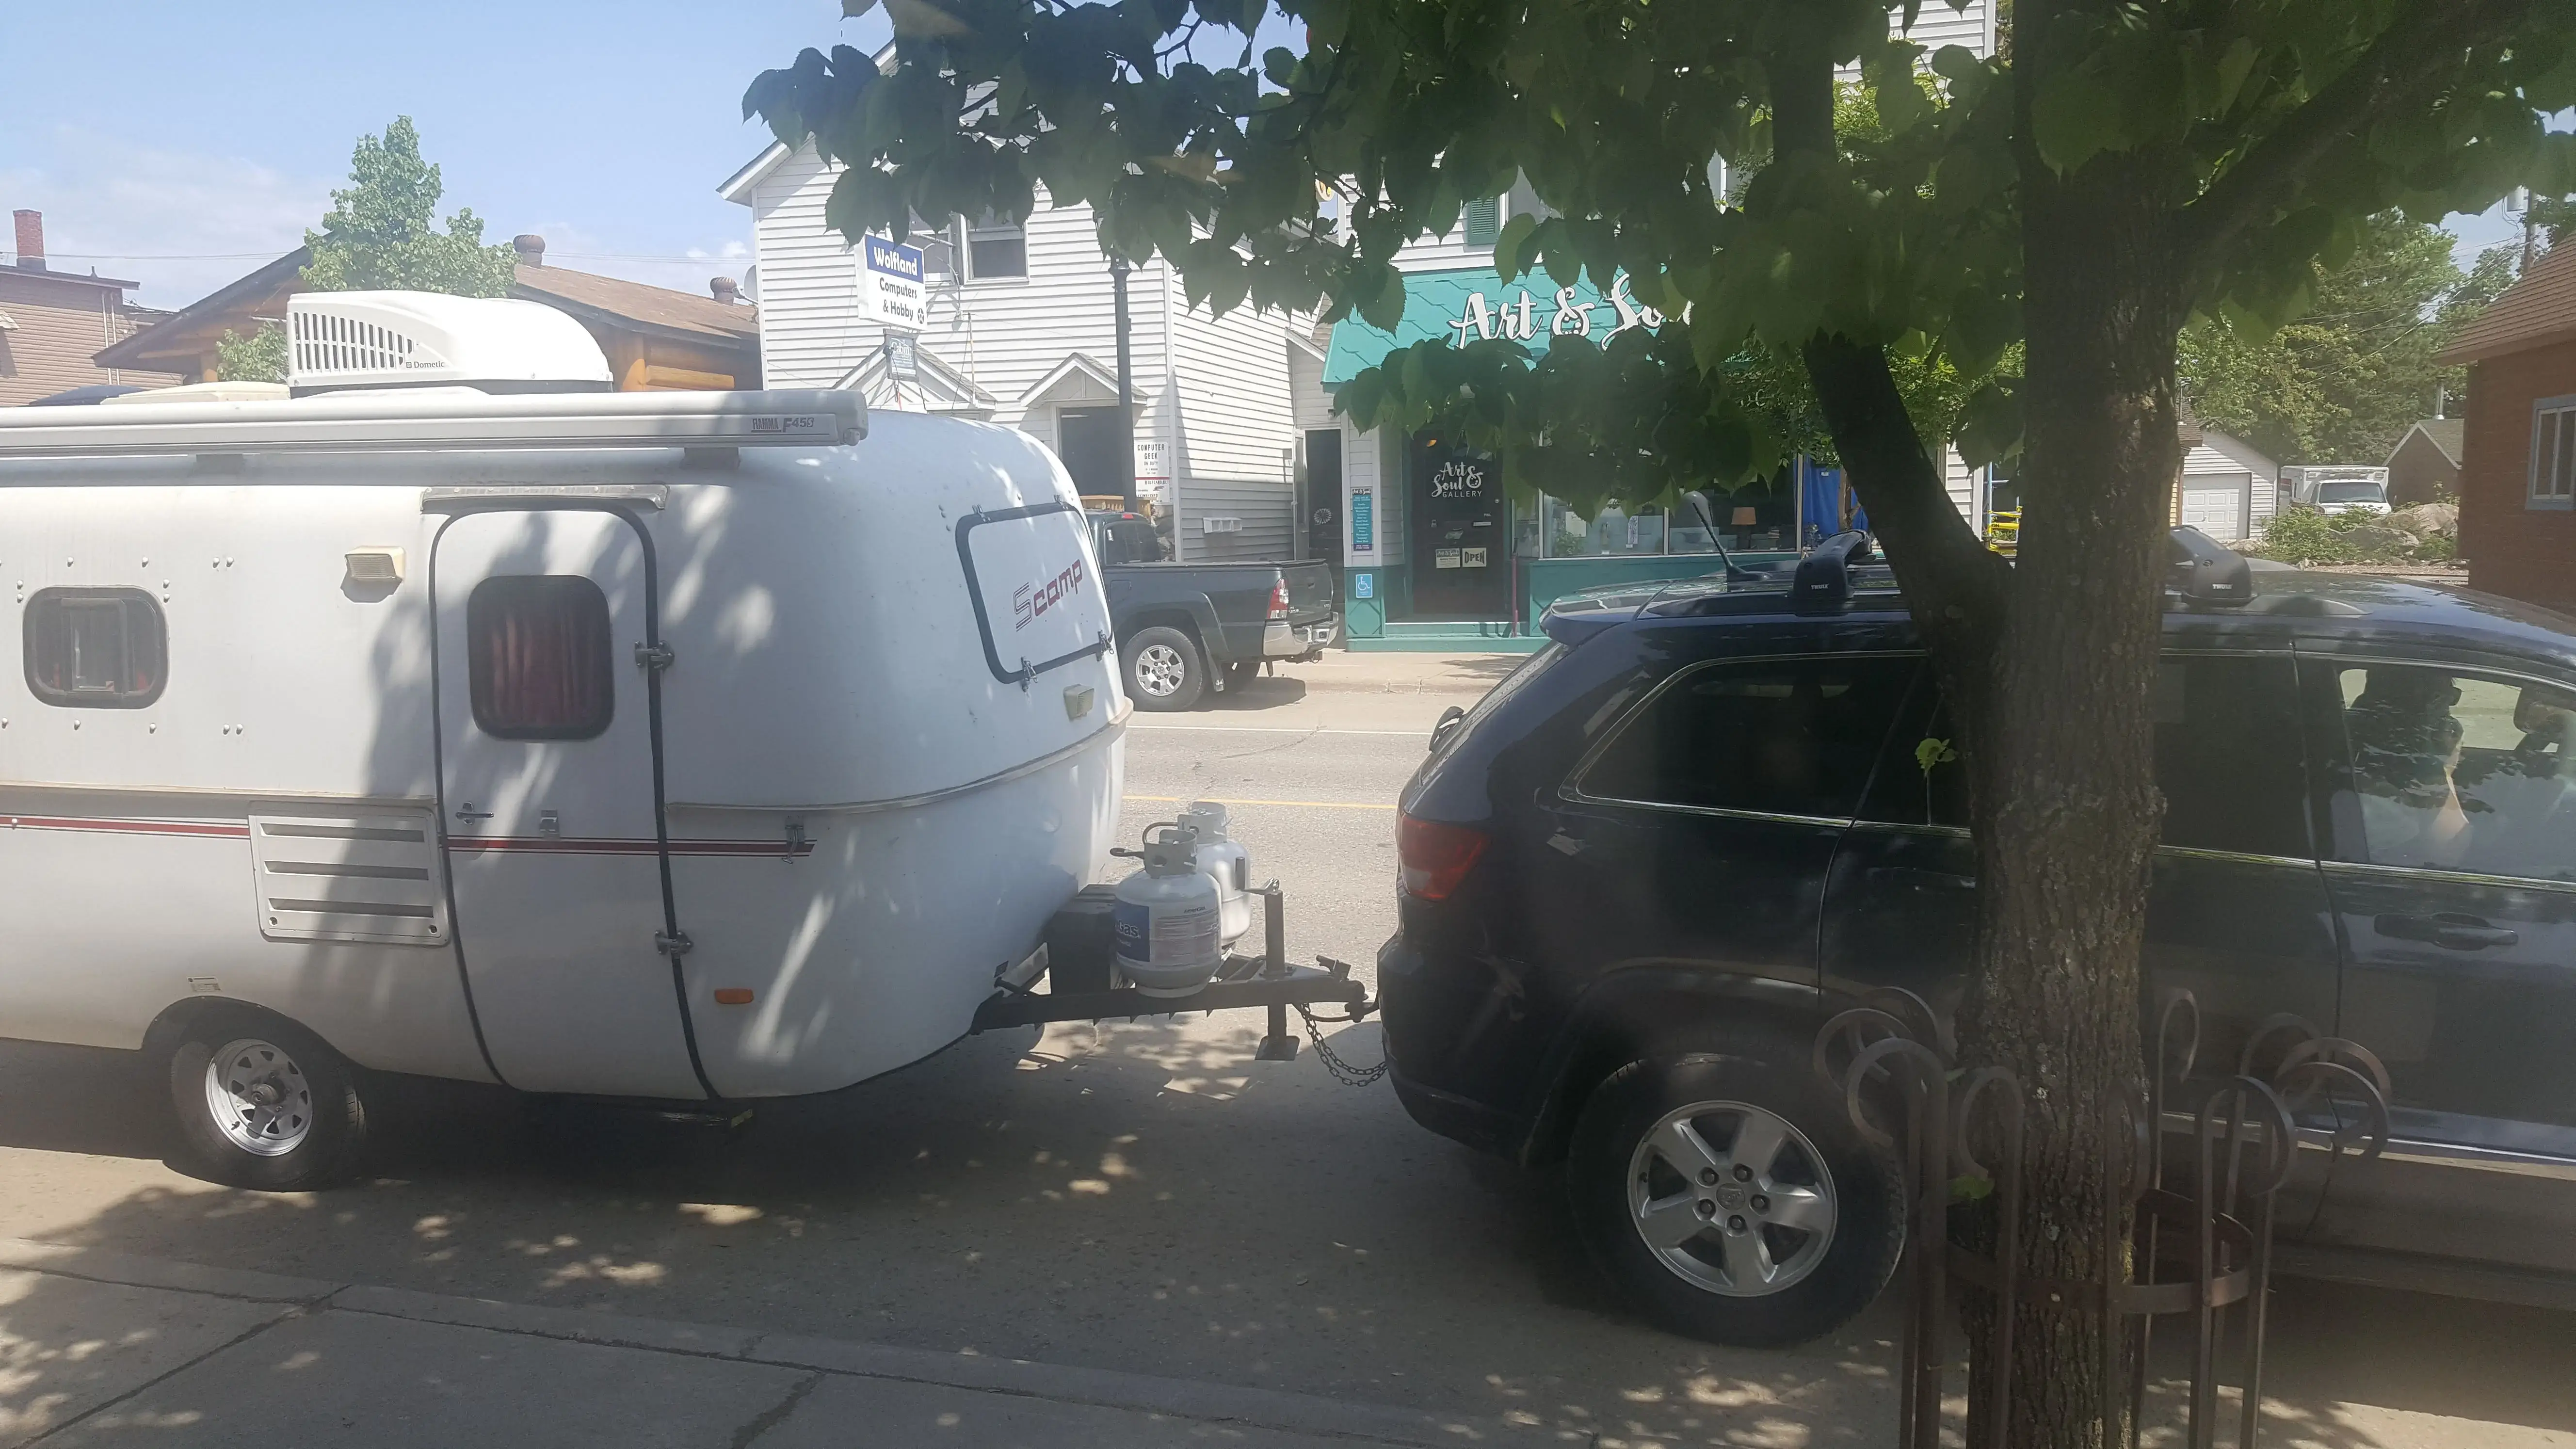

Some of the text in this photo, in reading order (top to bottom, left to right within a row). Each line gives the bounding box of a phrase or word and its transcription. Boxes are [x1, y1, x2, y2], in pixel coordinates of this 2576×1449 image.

[873, 246, 918, 276] Wolfland
[879, 277, 917, 299] Computers
[883, 299, 914, 322] & Hobby
[1448, 290, 1543, 349] Art
[1551, 286, 1595, 337] &
[414, 360, 445, 369] Dometic
[752, 417, 779, 430] FIAMMA
[1431, 474, 1465, 498] Soul
[1439, 461, 1483, 489] Art &
[1465, 550, 1485, 564] OPEN
[1013, 559, 1083, 632] Scamp
